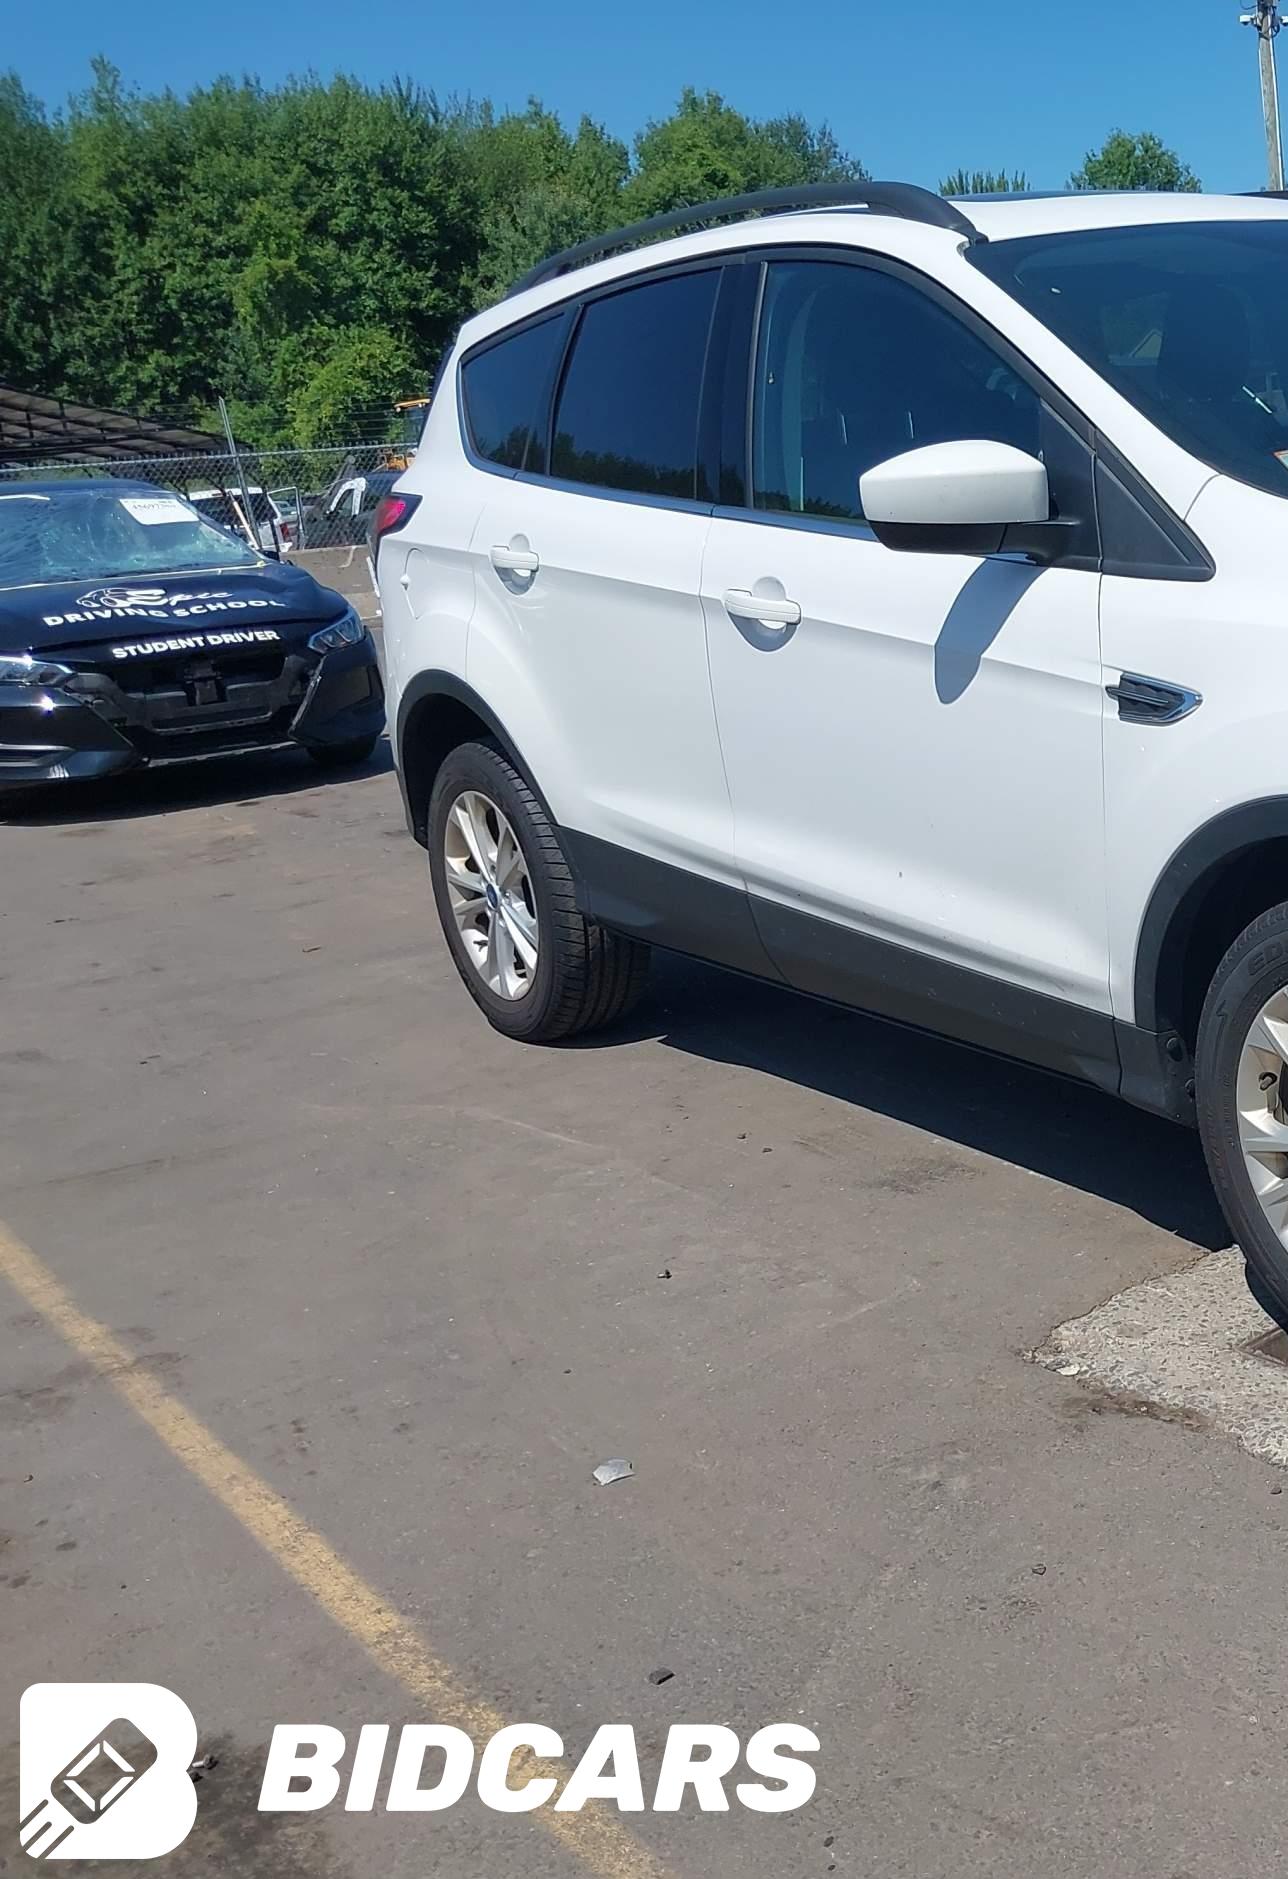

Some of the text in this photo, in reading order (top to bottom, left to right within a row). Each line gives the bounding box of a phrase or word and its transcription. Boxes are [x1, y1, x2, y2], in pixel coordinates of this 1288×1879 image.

[43, 599, 287, 627] DRIVING SCHOOL
[112, 630, 281, 659] STUDENT DRIVER
